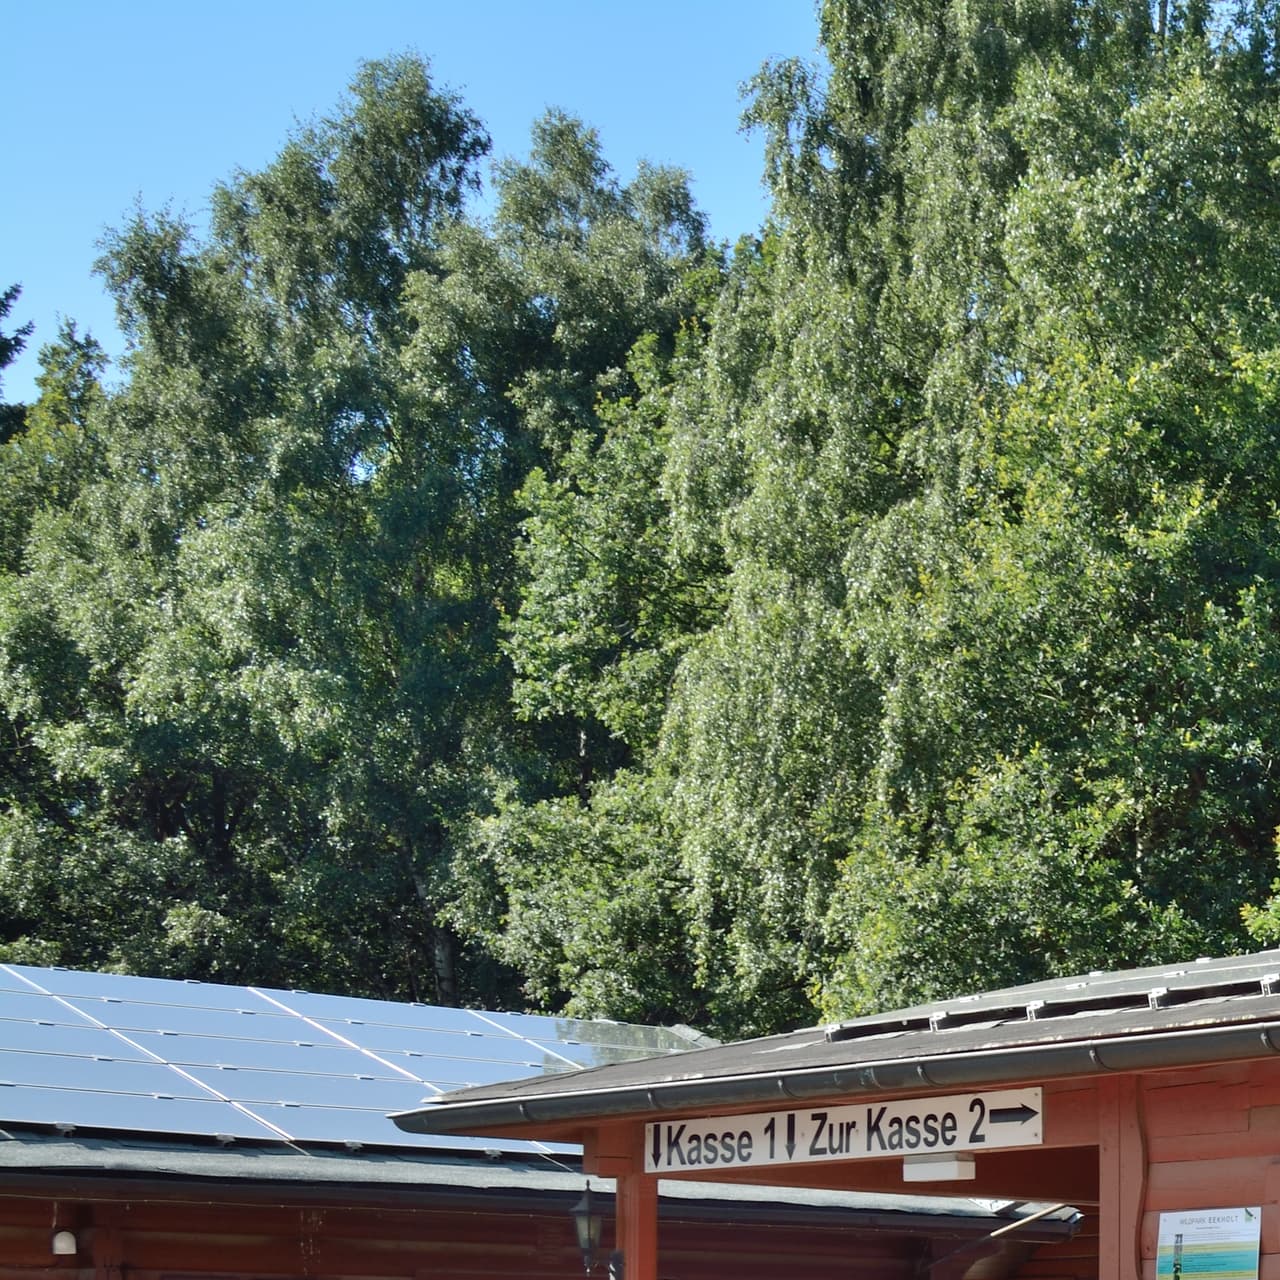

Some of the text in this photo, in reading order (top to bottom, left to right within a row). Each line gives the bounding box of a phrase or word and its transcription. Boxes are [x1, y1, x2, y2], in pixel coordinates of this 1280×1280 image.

[666, 1097, 986, 1166] Kasse 1 Zur Kasse 2
